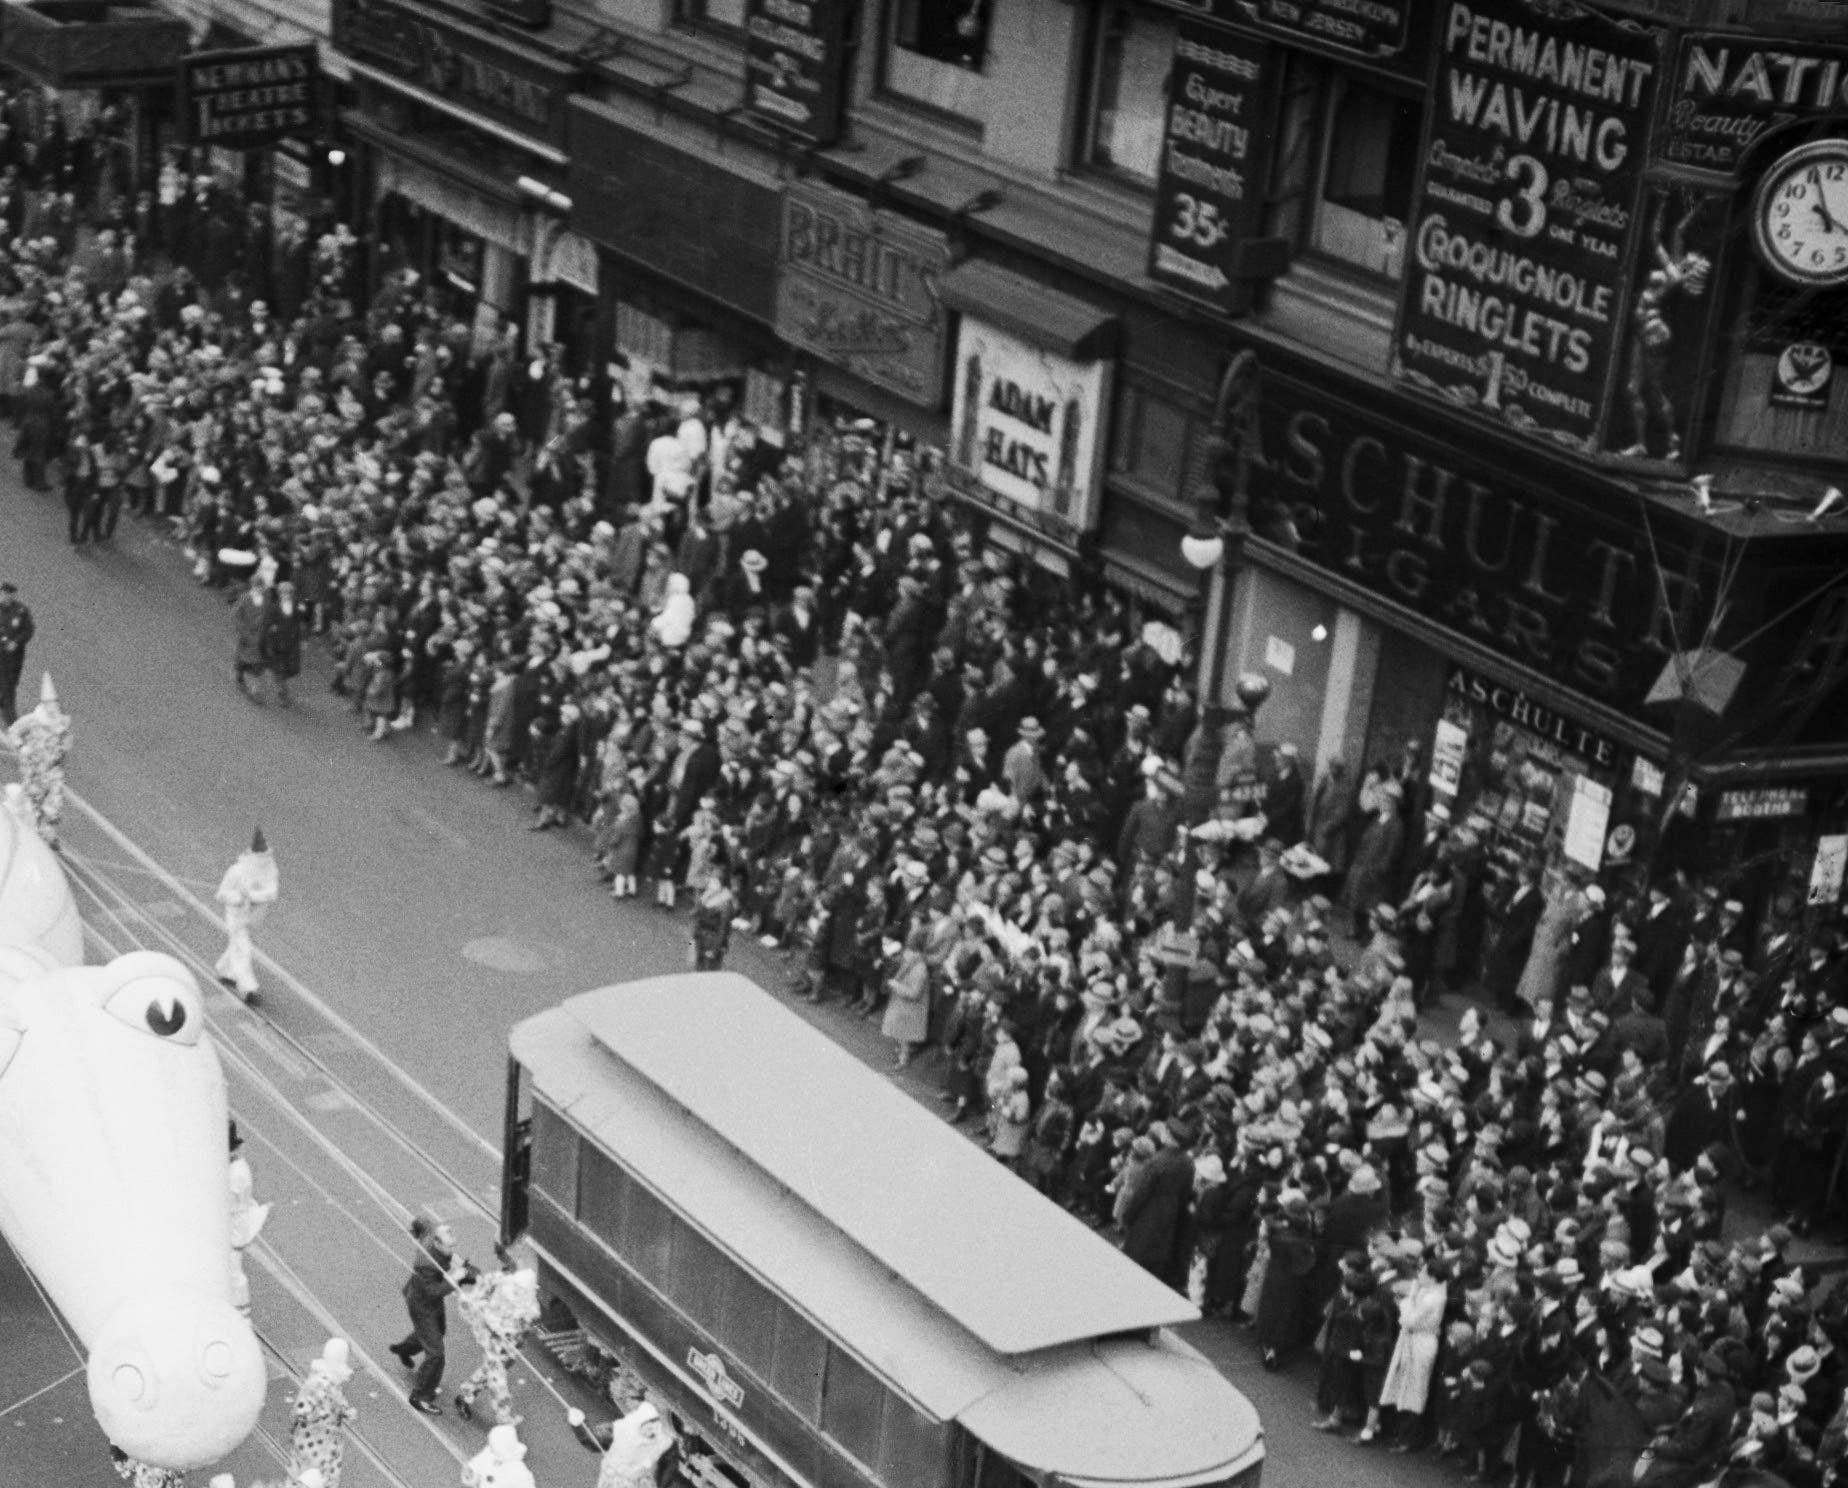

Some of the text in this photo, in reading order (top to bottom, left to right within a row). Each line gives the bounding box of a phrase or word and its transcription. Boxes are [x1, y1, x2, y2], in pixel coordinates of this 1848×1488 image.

[1446, 4, 1653, 108] PERMANENT
[1684, 45, 1848, 107] NATI
[1169, 103, 1249, 159] BEAUTY
[1449, 68, 1629, 170] WAVING
[1673, 99, 1767, 146] Beauty
[1786, 184, 1807, 200] 10
[1826, 165, 1844, 181] 12
[1778, 202, 1790, 218] 9
[1416, 213, 1614, 322] CROQUIGNOLE
[1549, 224, 1576, 245] ONE
[1581, 233, 1618, 259] YEAR
[1793, 241, 1804, 257] 7
[1812, 250, 1824, 265] 6
[1421, 274, 1592, 373] RINGLETS
[990, 377, 1056, 437] ADAM
[985, 426, 1049, 489] HATS
